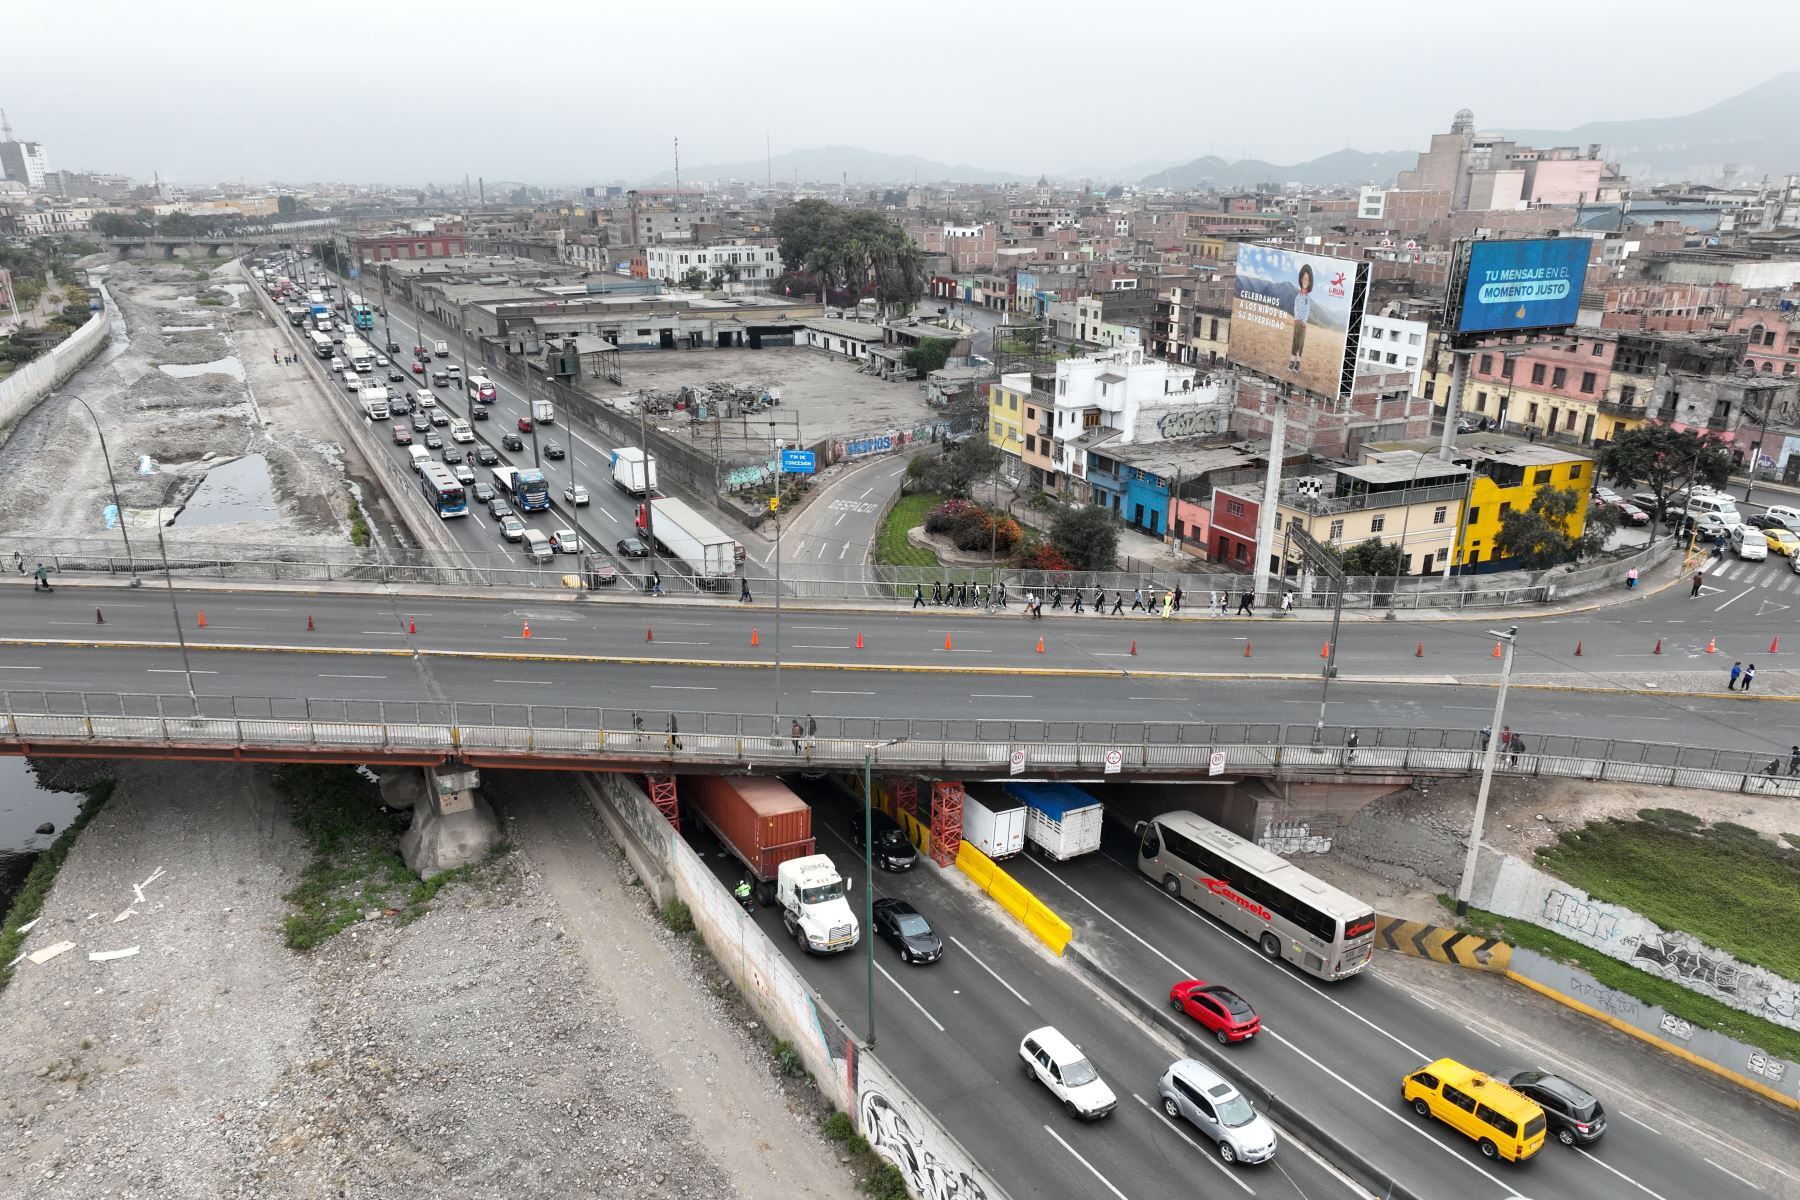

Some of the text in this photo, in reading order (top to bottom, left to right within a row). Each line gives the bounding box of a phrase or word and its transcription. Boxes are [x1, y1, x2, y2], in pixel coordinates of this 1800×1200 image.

[1485, 266, 1570, 281] TU MENSAJE EN EL
[1240, 289, 1280, 306] CELEBRAMOS
[1484, 283, 1565, 298] MOMENTO JUSTO
[1245, 302, 1257, 311] LOS
[1258, 303, 1278, 317] NIÑOS
[1279, 310, 1288, 319] EN
[1238, 311, 1285, 330] SU DIVERSIDAD
[828, 499, 879, 514] DESPACIO
[1199, 878, 1272, 921] Carmelo
[1346, 920, 1375, 937] Carmelo
